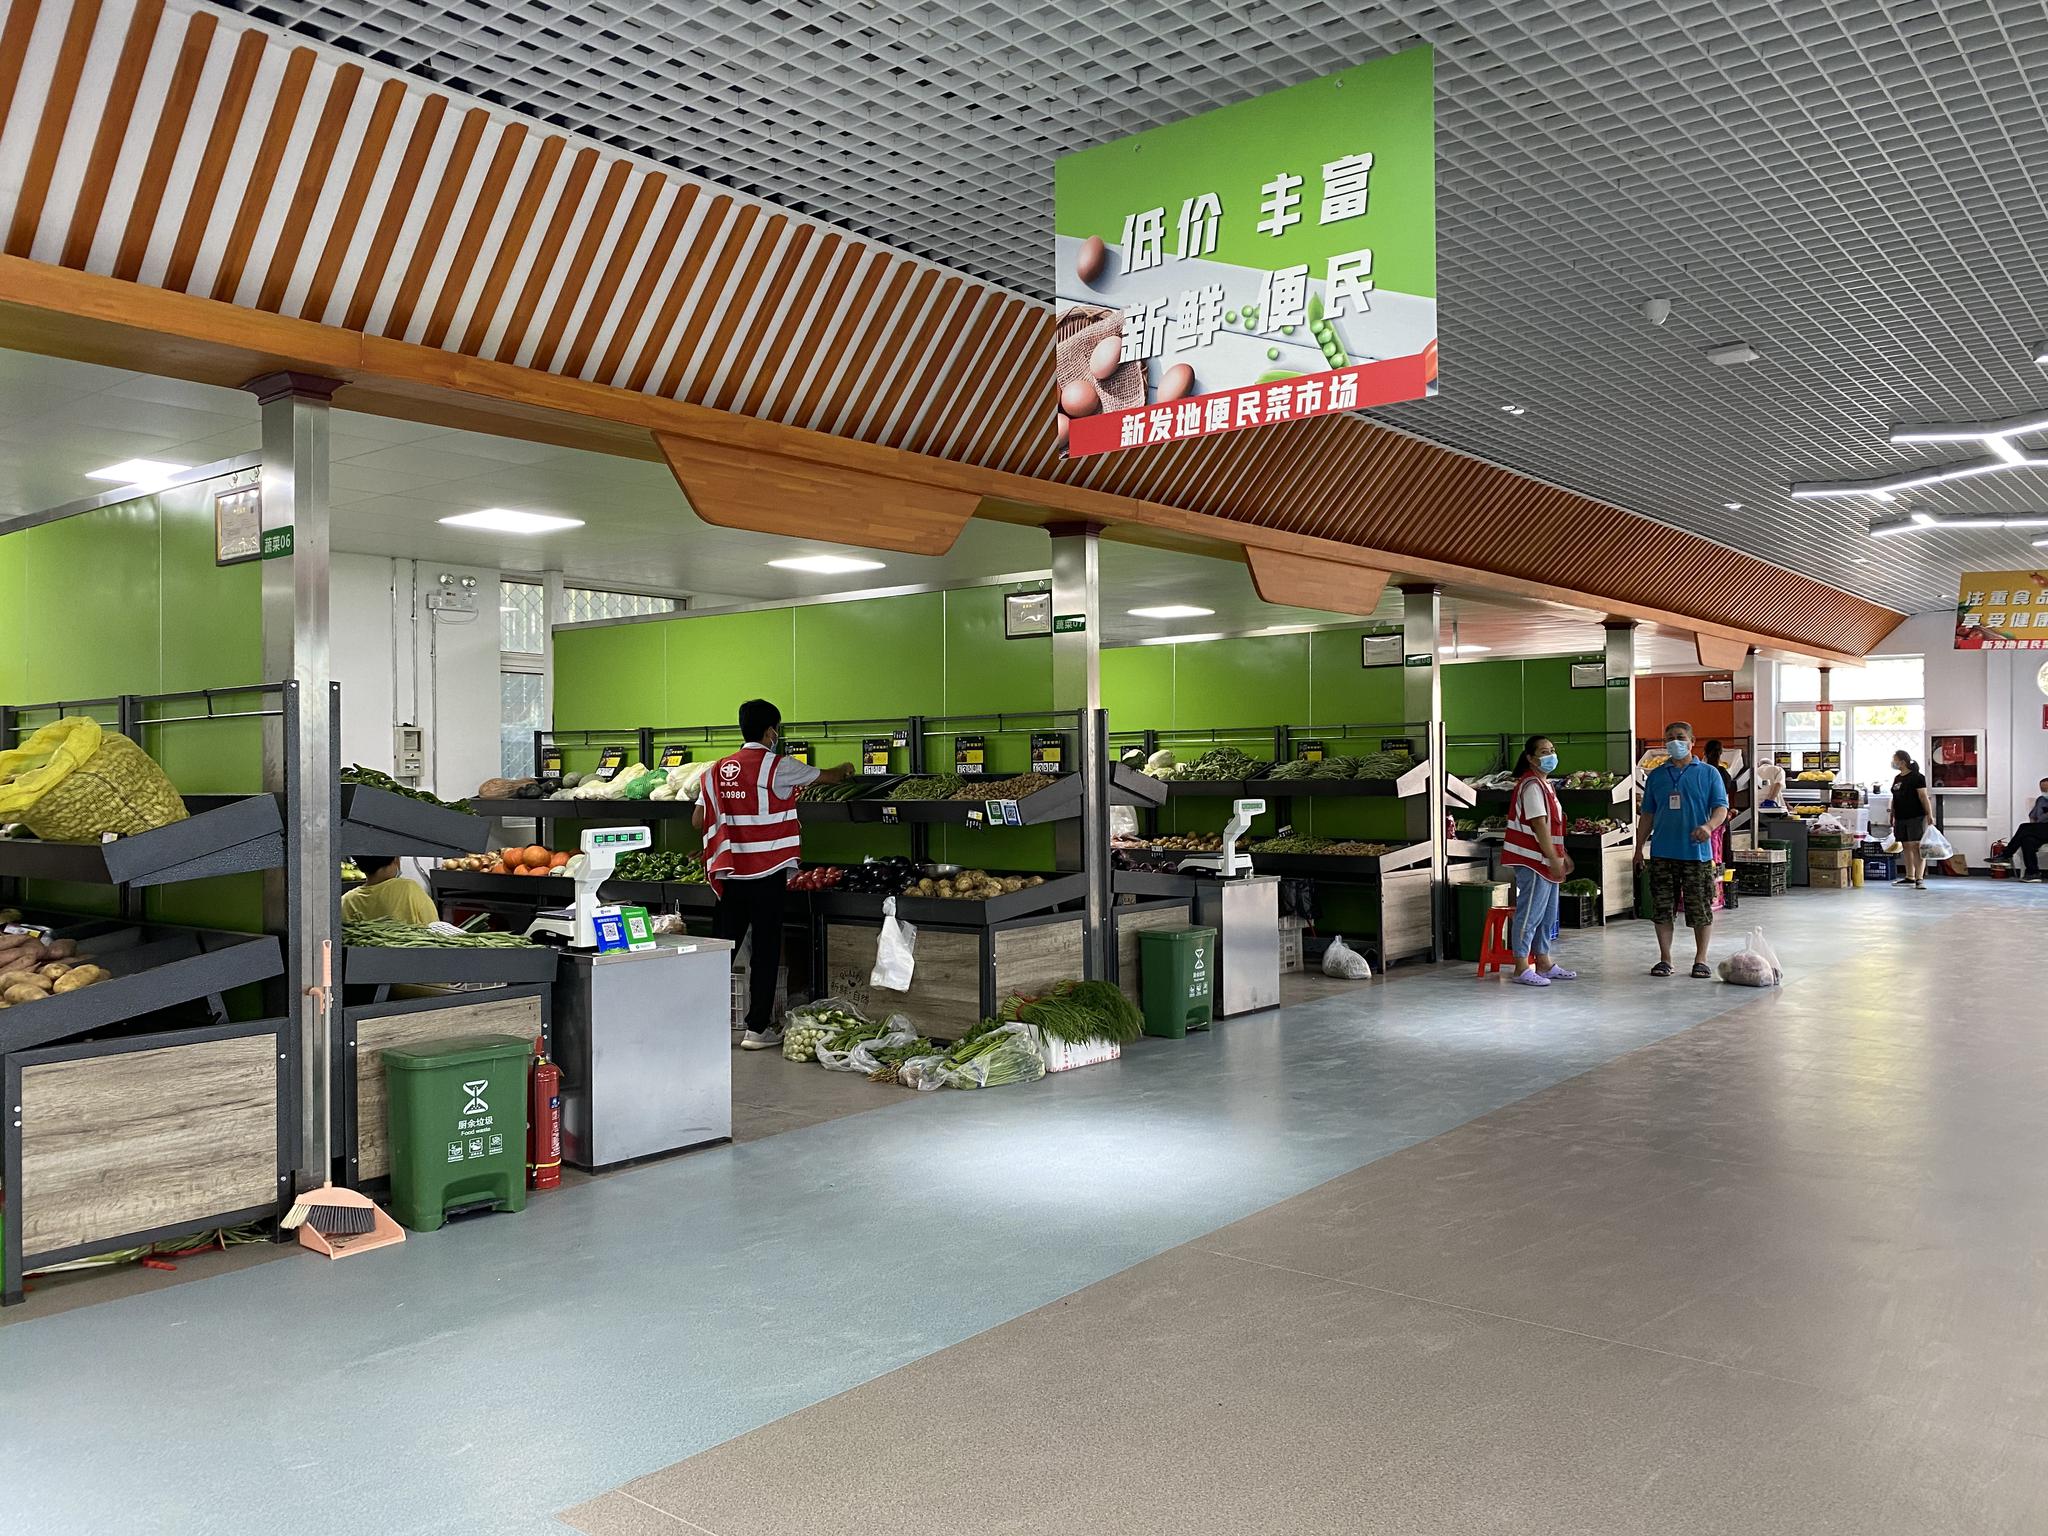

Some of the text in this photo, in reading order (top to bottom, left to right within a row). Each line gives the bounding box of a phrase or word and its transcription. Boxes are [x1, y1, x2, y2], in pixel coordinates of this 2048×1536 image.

[1120, 152, 1375, 275] 低价 丰富
[1118, 249, 1375, 363] 新鲜 便民
[1119, 372, 1359, 448] 新发地便民菜市场
[264, 533, 291, 553] 蔬菜06
[458, 1116, 494, 1130] 厨余垃圾
